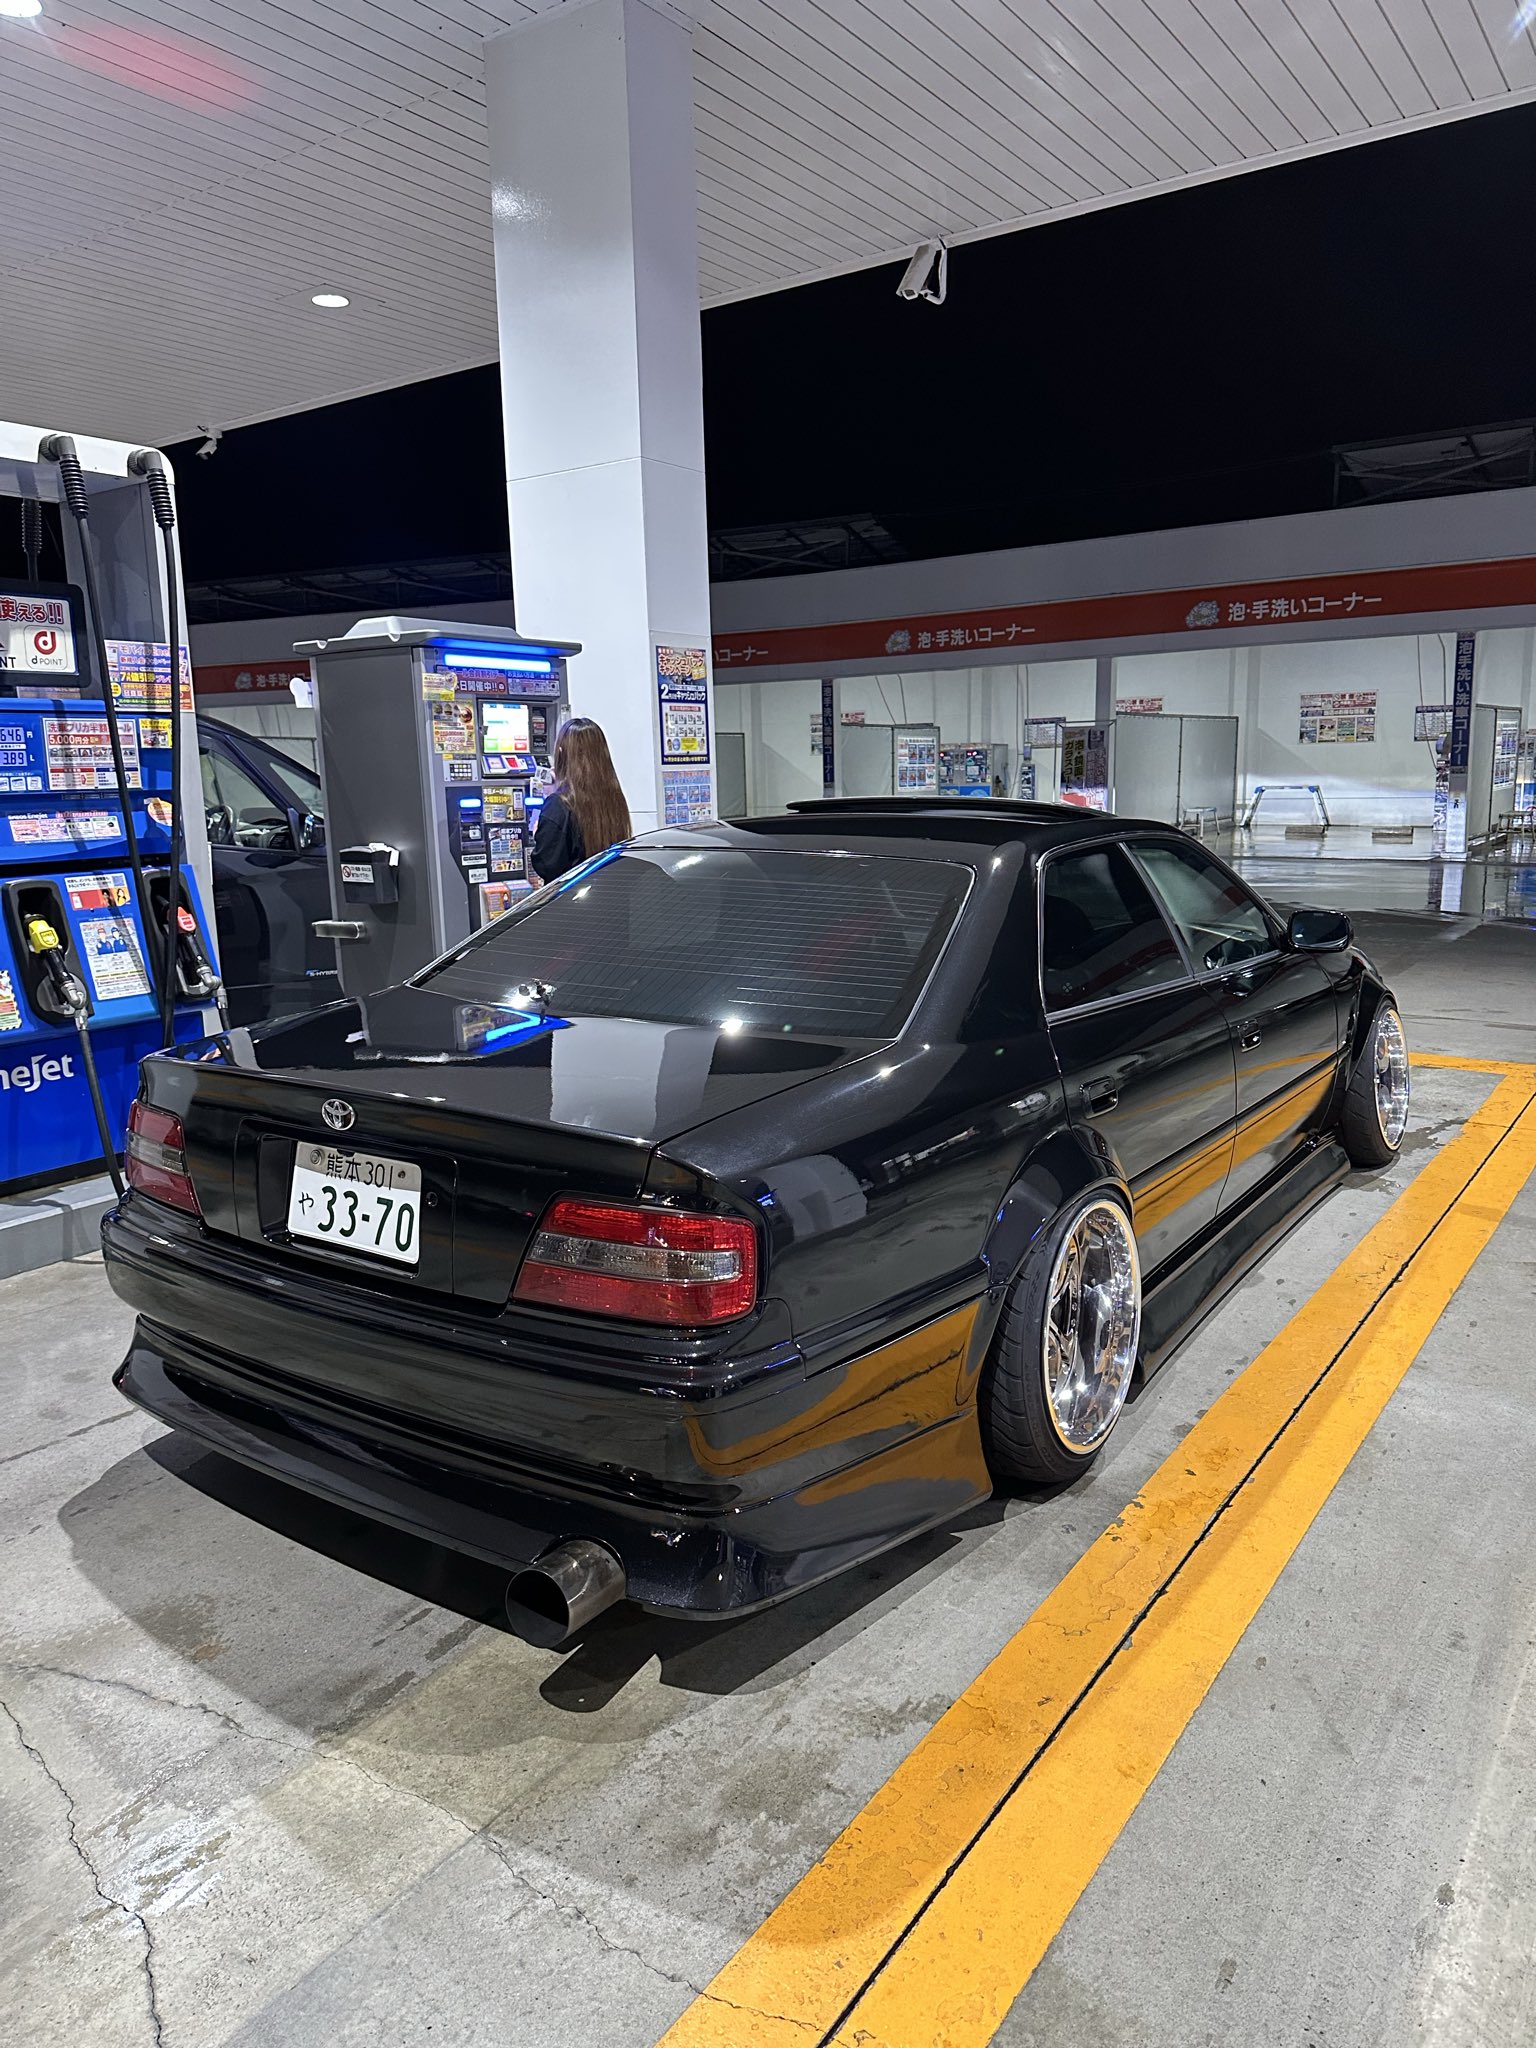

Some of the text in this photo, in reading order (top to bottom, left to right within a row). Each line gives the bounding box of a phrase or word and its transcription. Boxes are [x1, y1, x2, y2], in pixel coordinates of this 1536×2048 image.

[1227, 592, 1383, 622] 泡・手洗いコーナー
[917, 623, 1036, 649] 泡・手洗いコーナー
[456, 680, 498, 692] 日開催中!!
[1452, 641, 1473, 765] 泡手洗い洗車コーナー
[0, 729, 21, 742] 646
[48, 721, 132, 733] 洗車プリカ半額ール
[29, 754, 35, 762] L
[1065, 741, 1073, 792] ガラスコート
[326, 1153, 394, 1190] 熊本 301
[298, 1186, 415, 1252] や 33-70
